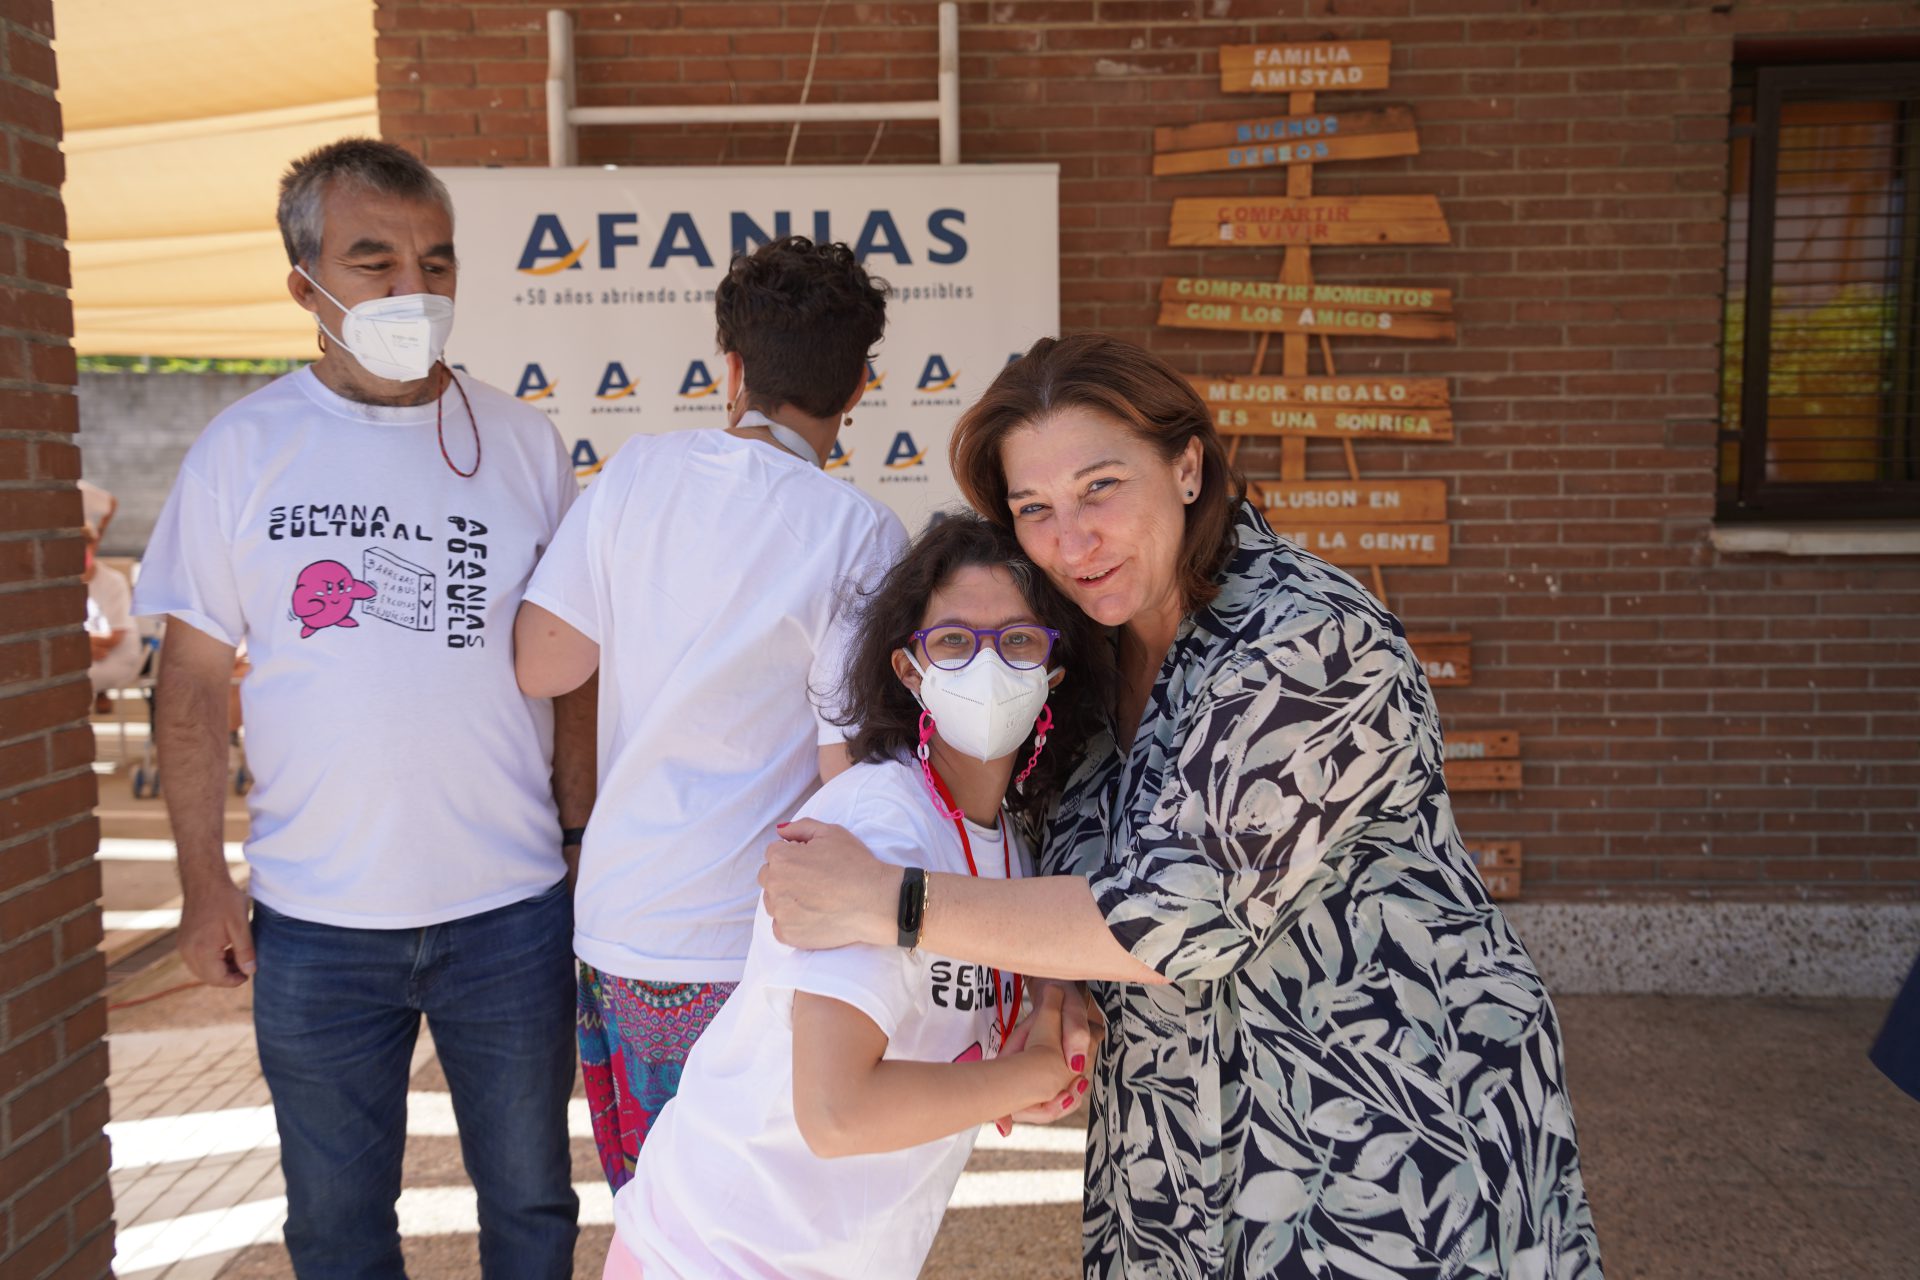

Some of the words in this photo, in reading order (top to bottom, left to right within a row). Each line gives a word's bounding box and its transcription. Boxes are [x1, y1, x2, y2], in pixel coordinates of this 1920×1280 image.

[1254, 46, 1351, 66] FAMILIA
[1251, 66, 1363, 87] AMISTAD
[1236, 116, 1339, 142] BUENOS
[1217, 206, 1350, 223] COMPARTIR
[515, 207, 968, 272] AFANIAS
[1219, 223, 1247, 240] ES
[1258, 223, 1329, 240] VIVIR
[515, 288, 546, 305] +50
[554, 288, 593, 305] años
[601, 287, 676, 304] abriendo
[891, 282, 974, 304] mposibles
[1176, 277, 1310, 301] COMPARTIR
[1313, 285, 1434, 307] MOMENTOS
[1186, 303, 1231, 321] CON
[1241, 306, 1284, 323] LOS
[1298, 308, 1392, 330] AMIGOS
[1209, 383, 1287, 402] MEJOR
[1304, 383, 1406, 402] REGALO
[1217, 409, 1248, 427] ES
[1271, 410, 1317, 429] UNA
[1335, 411, 1431, 434] SONRISA
[1264, 490, 1357, 508] ILUSION
[1369, 491, 1400, 508] EN
[269, 504, 391, 523] SEMANA
[269, 520, 434, 542] CULTURAL
[1318, 531, 1347, 549] LA
[1359, 532, 1436, 552] GENTE
[446, 515, 468, 649] POZUELO
[466, 519, 488, 649] AFANIAS
[1442, 742, 1485, 759] ION
